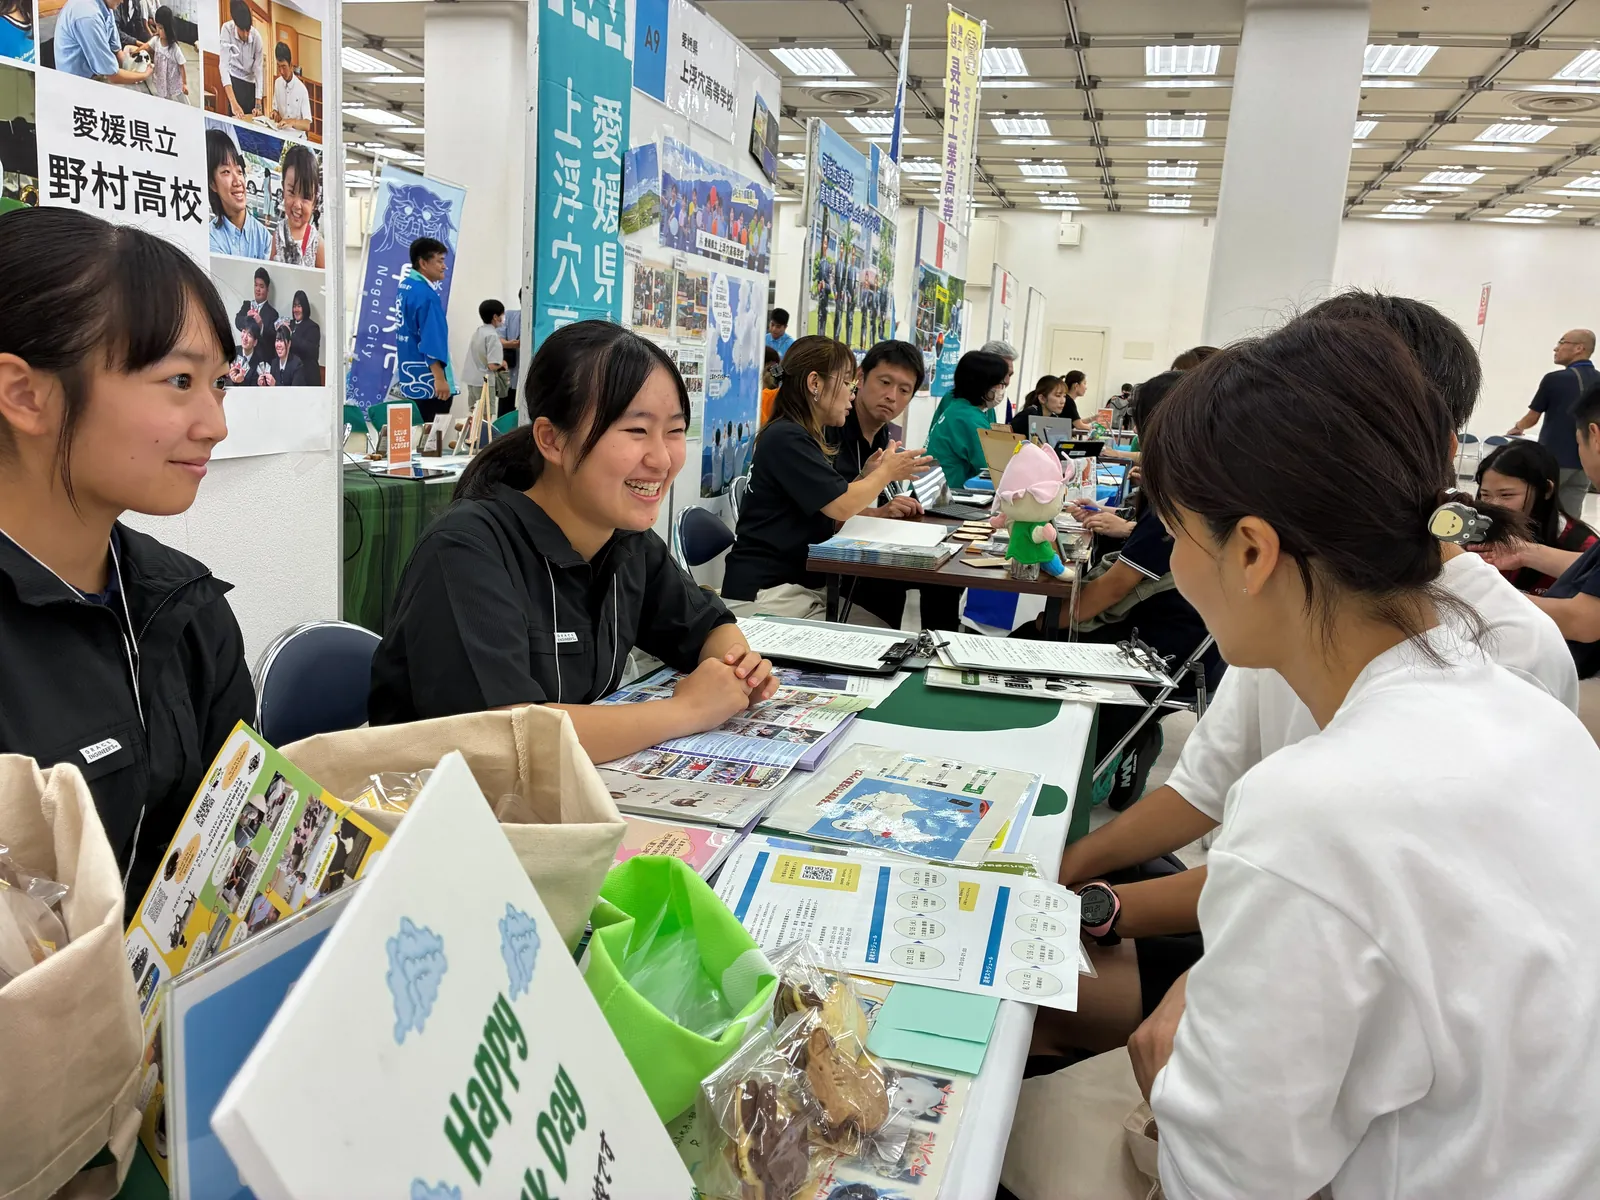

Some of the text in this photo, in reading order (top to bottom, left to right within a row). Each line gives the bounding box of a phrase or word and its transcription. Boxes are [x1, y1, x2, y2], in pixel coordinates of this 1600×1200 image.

[645, 25, 660, 53] A9
[680, 60, 734, 113] 上浮穴高等学校
[72, 105, 179, 158] 愛媛県立
[48, 153, 203, 225] 野村高校
[592, 94, 622, 318] 愛媛県
[362, 265, 388, 359] Nagai City
[443, 991, 528, 1186] Happy
[536, 1063, 587, 1184] Day
[932, 1083, 955, 1115] ハート
